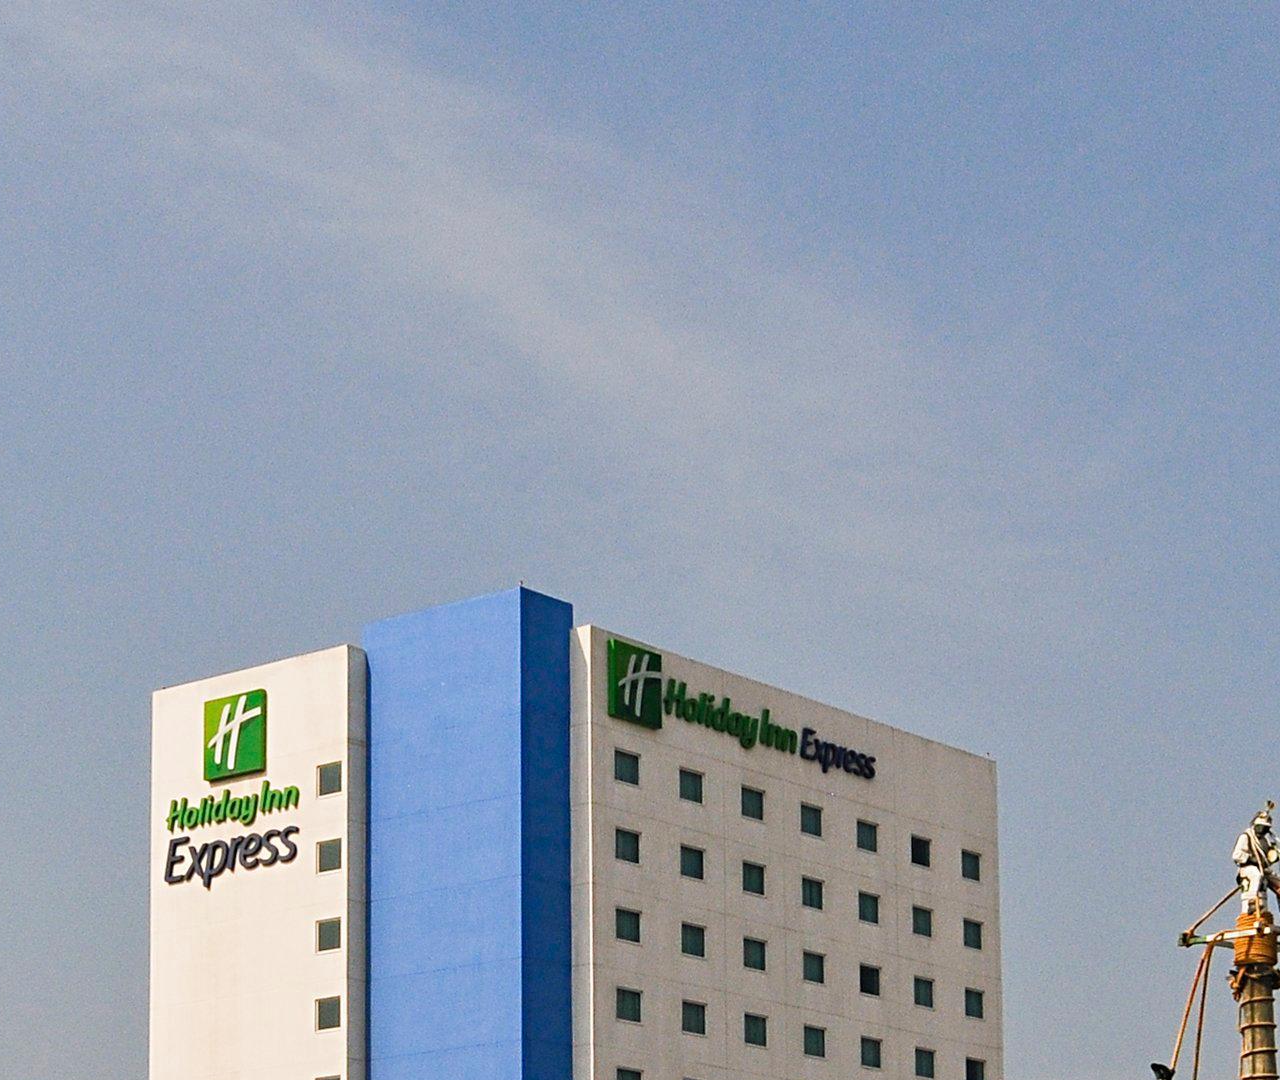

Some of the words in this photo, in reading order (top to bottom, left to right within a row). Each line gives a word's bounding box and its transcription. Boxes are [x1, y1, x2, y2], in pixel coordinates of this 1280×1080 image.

[663, 678, 759, 749] Holiday
[759, 708, 798, 754] Inn
[799, 728, 876, 779] Express
[166, 789, 259, 833] Holiday
[259, 780, 300, 814] Inn
[164, 825, 300, 890] Express
